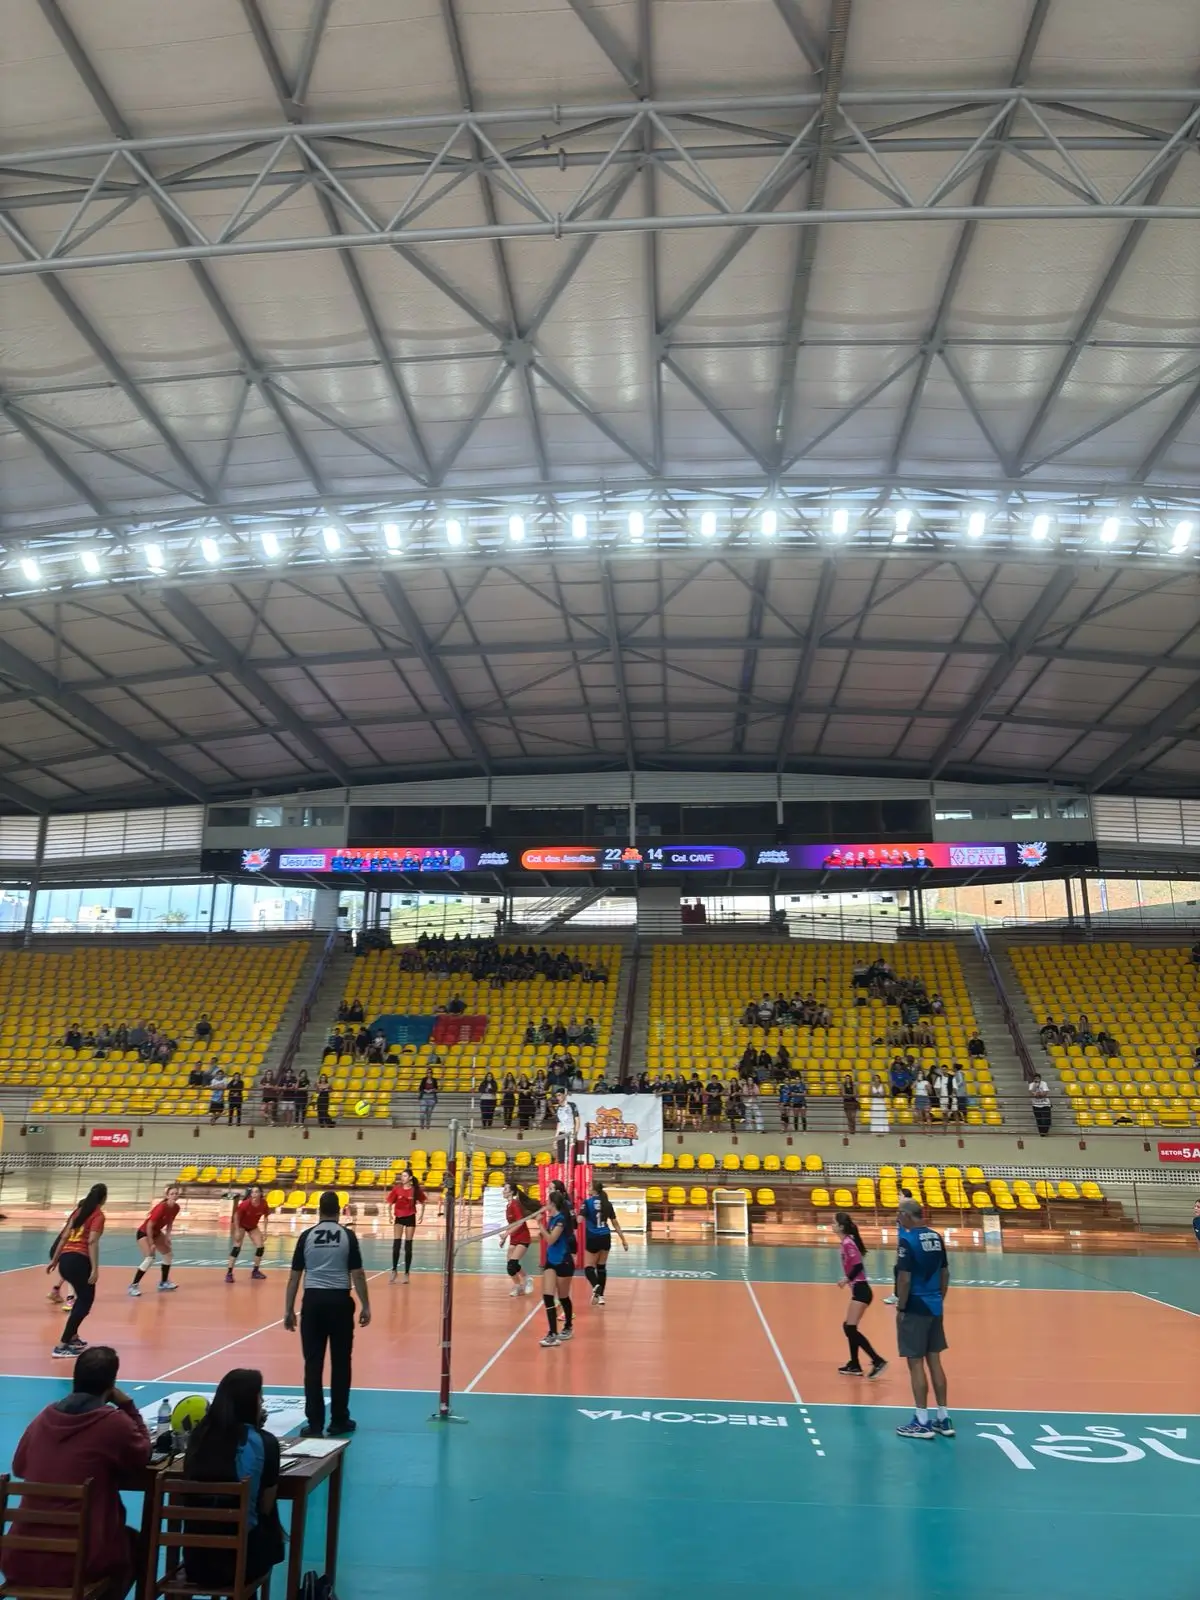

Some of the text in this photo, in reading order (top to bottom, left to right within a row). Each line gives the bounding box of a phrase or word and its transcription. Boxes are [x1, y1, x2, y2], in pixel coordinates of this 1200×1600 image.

[604, 848, 622, 861] 22
[647, 848, 664, 860] 14
[689, 854, 714, 862] CAVE
[967, 854, 1006, 865] CAVE
[112, 1133, 129, 1143] 5A
[314, 1230, 341, 1244] ZM
[577, 1409, 789, 1427] RECOMA
[975, 1422, 1188, 1440] ASIL
